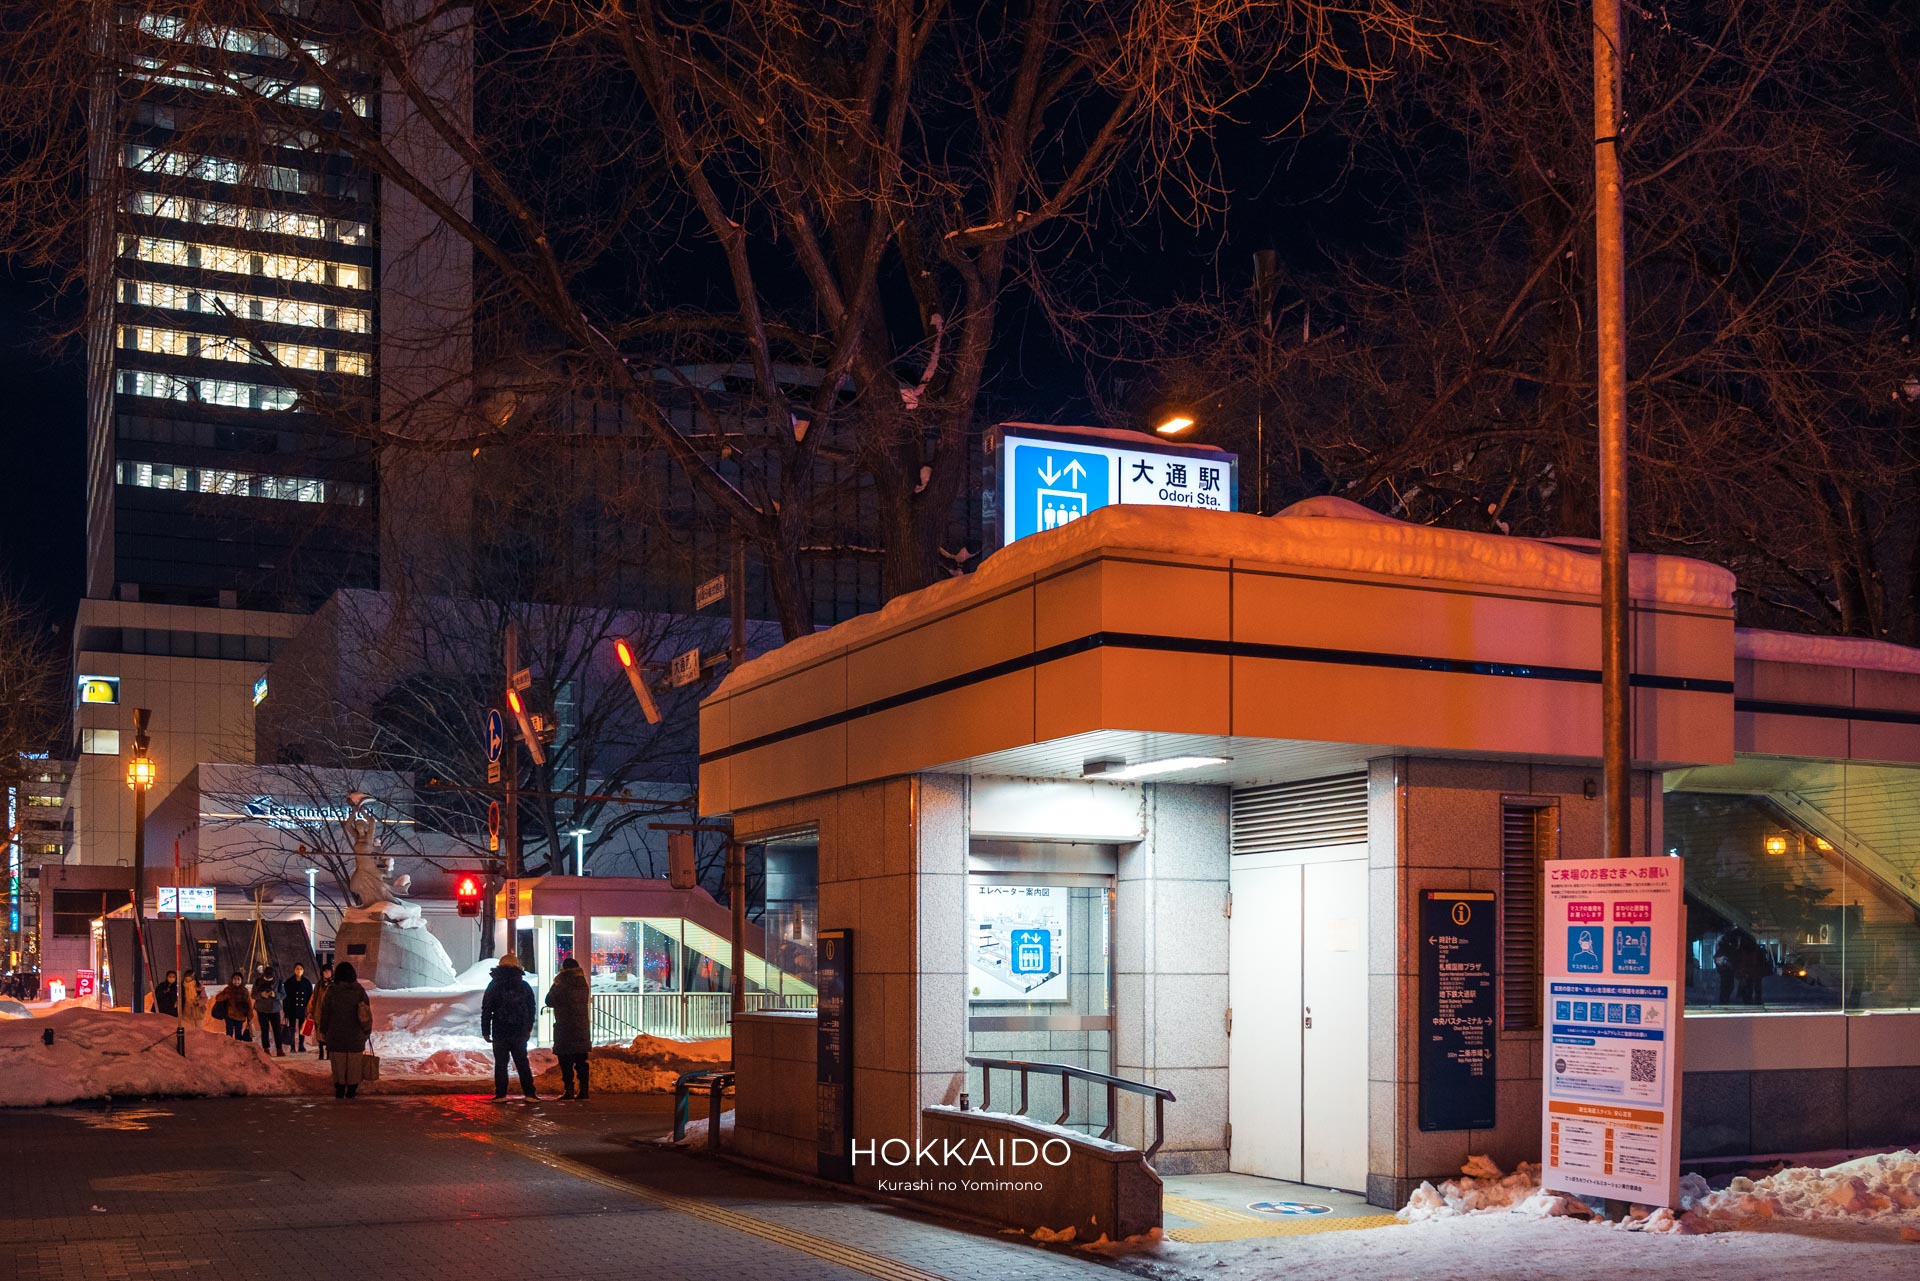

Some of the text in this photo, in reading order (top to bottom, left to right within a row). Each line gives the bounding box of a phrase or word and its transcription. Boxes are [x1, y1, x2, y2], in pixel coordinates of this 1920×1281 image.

[1132, 459, 1221, 492] 大通駅
[1159, 488, 1221, 506] Odori Sta.
[1551, 866, 1670, 881] ご来場のお客さまへお願い
[979, 886, 1050, 897] エレベーター案内図
[1625, 935, 1639, 946] 2m
[1432, 1017, 1484, 1025] 中央バスターミナル
